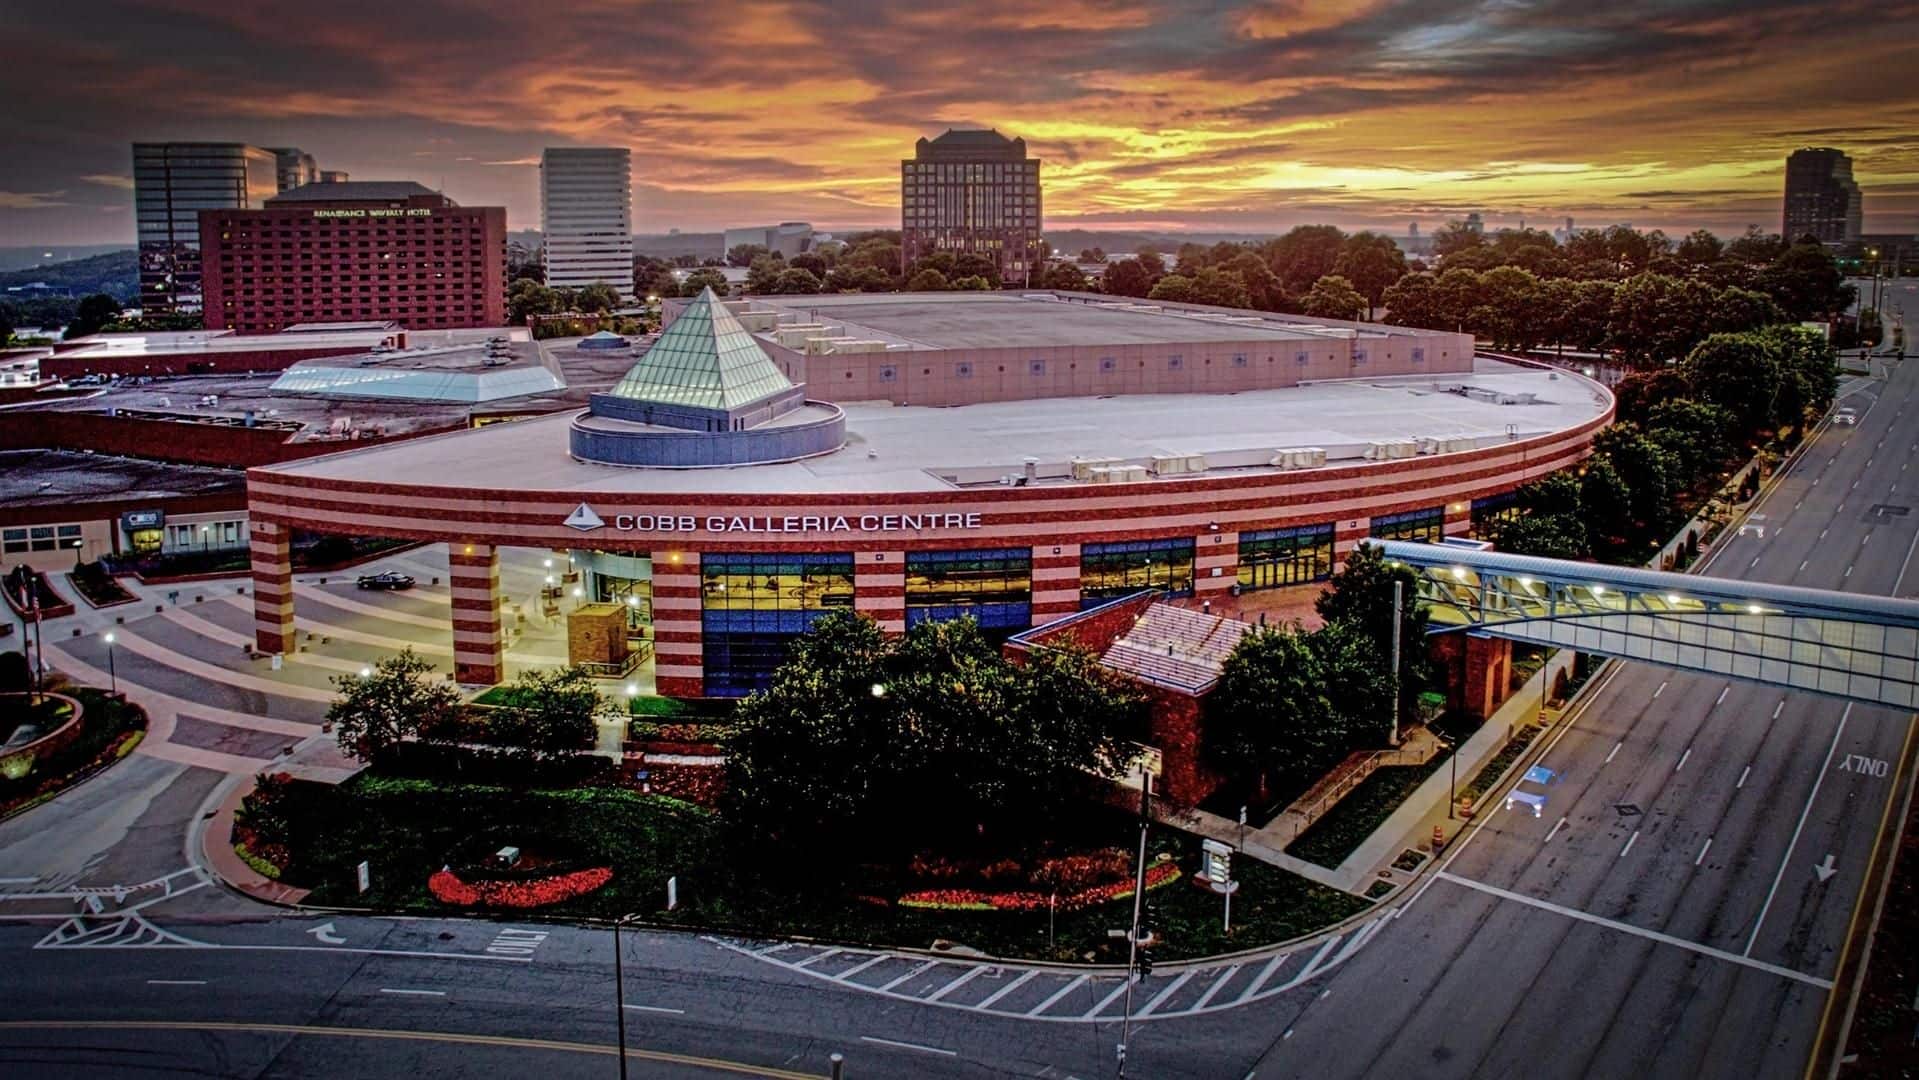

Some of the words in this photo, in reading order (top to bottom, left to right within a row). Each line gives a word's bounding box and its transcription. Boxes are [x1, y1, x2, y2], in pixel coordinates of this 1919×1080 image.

[407, 208, 432, 216] HOTEL
[616, 515, 696, 531] COBB
[706, 516, 850, 532] GALLERIA
[860, 513, 982, 531] CENTRE
[1839, 754, 1889, 777] ONLY
[487, 928, 550, 954] ONLY
